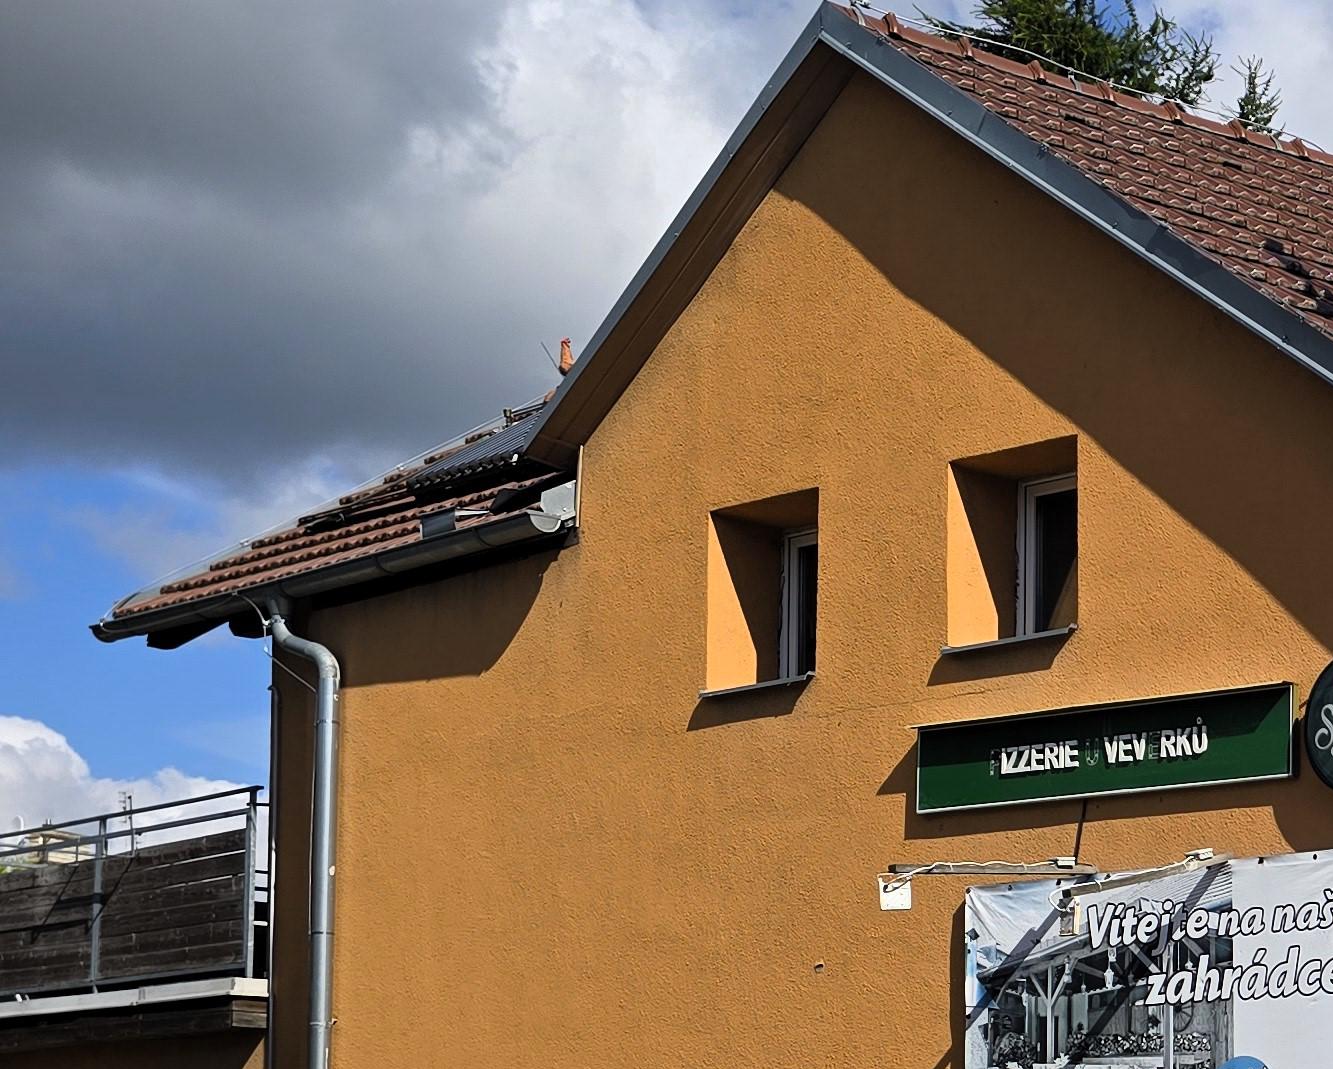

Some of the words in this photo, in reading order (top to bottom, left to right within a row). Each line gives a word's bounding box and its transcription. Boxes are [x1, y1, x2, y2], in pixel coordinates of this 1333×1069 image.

[1084, 737, 1099, 766] U
[1086, 899, 1211, 957] Vítejte
[1217, 906, 1266, 937] na
